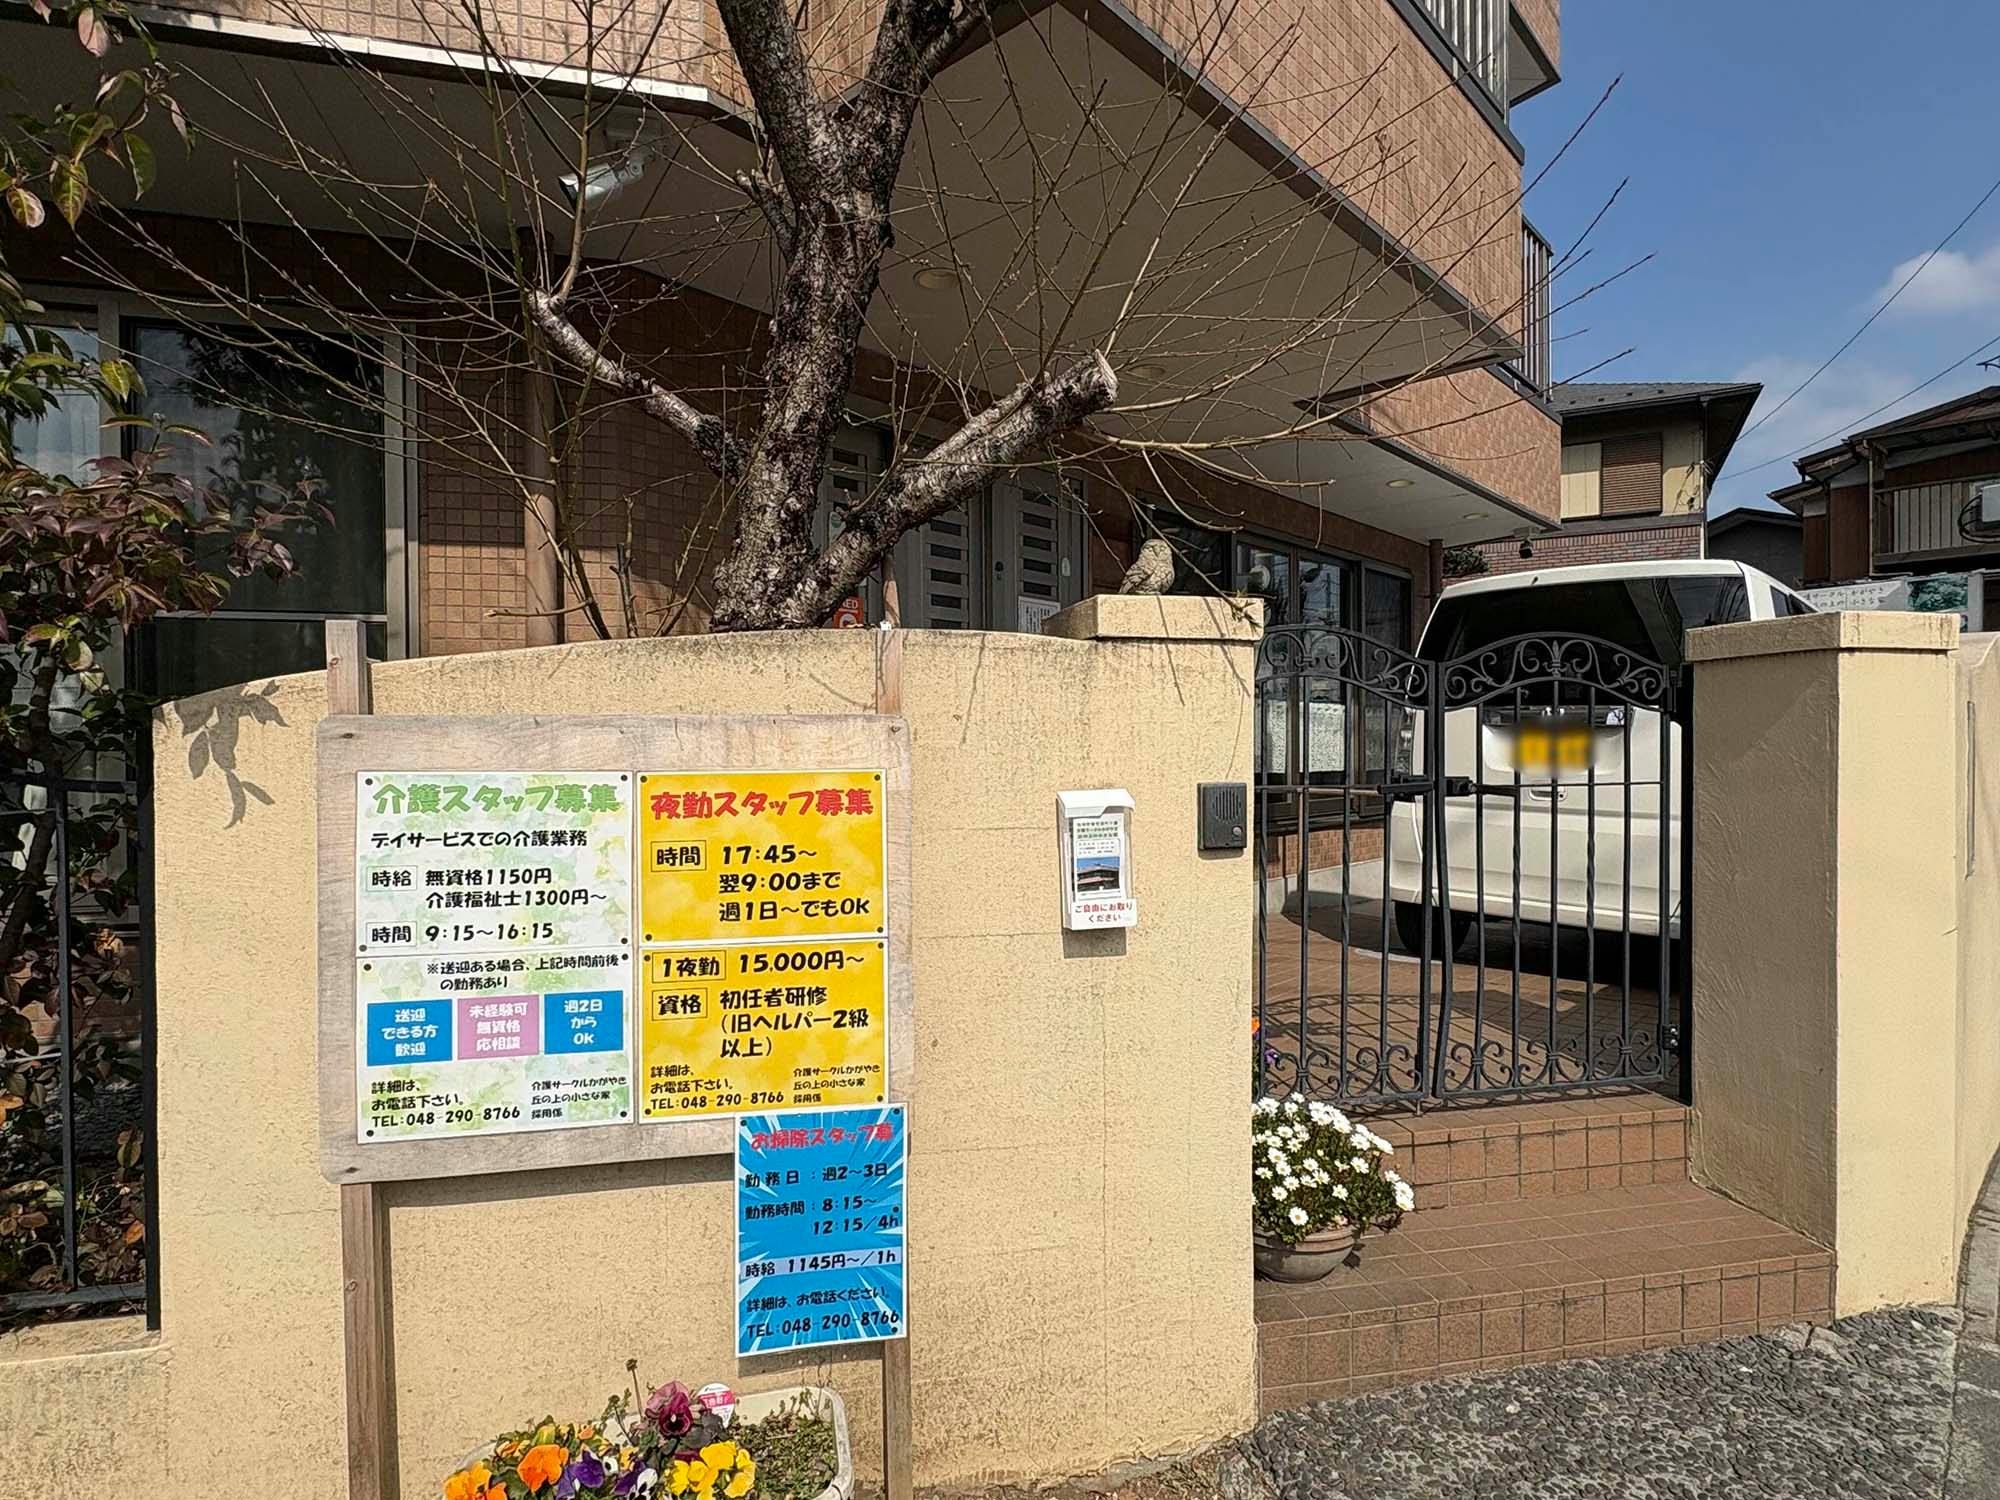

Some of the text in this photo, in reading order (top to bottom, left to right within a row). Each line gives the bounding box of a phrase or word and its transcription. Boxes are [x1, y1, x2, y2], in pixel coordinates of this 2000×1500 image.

[372, 783, 621, 815] 介護スタッフ募集
[650, 789, 874, 820] 夜勤スタッフ募集
[371, 830, 588, 849] デイサービスでの介護業務
[656, 844, 817, 867] 時間 17:45～
[371, 867, 552, 888] 時給 無資格1150円
[719, 871, 841, 894] 翌9:00まで
[425, 888, 607, 909] 介護福祉士1300円～
[719, 897, 871, 923] 週1日～でもOK
[371, 922, 553, 944] 時間 9:15～16:15
[662, 956, 720, 978] 1夜勤
[440, 976, 508, 992] の勤務あり
[563, 999, 603, 1014] 週2日
[658, 986, 828, 1016] 資格 初任者研修
[394, 1008, 426, 1023] 送迎
[469, 1002, 528, 1018] 未経験可
[476, 1020, 521, 1035] 無資格
[570, 1015, 597, 1030] から
[721, 1007, 869, 1034] (旧ヘルパー2級
[381, 1024, 439, 1040] できる方
[573, 1034, 595, 1045] OK
[395, 1042, 426, 1057] 歓迎
[476, 1036, 521, 1052] 応相談
[720, 1036, 773, 1059] 以上)
[371, 1079, 421, 1095] 詳細は、
[531, 1077, 627, 1092] 介護サークルかがやき
[650, 1078, 734, 1095] お電話下さい。
[793, 1077, 866, 1091] 丘の上の小さな家
[371, 1093, 464, 1112] お電話下さい。
[531, 1091, 611, 1106] 丘の上の小さな家
[745, 1261, 776, 1278] 時給
